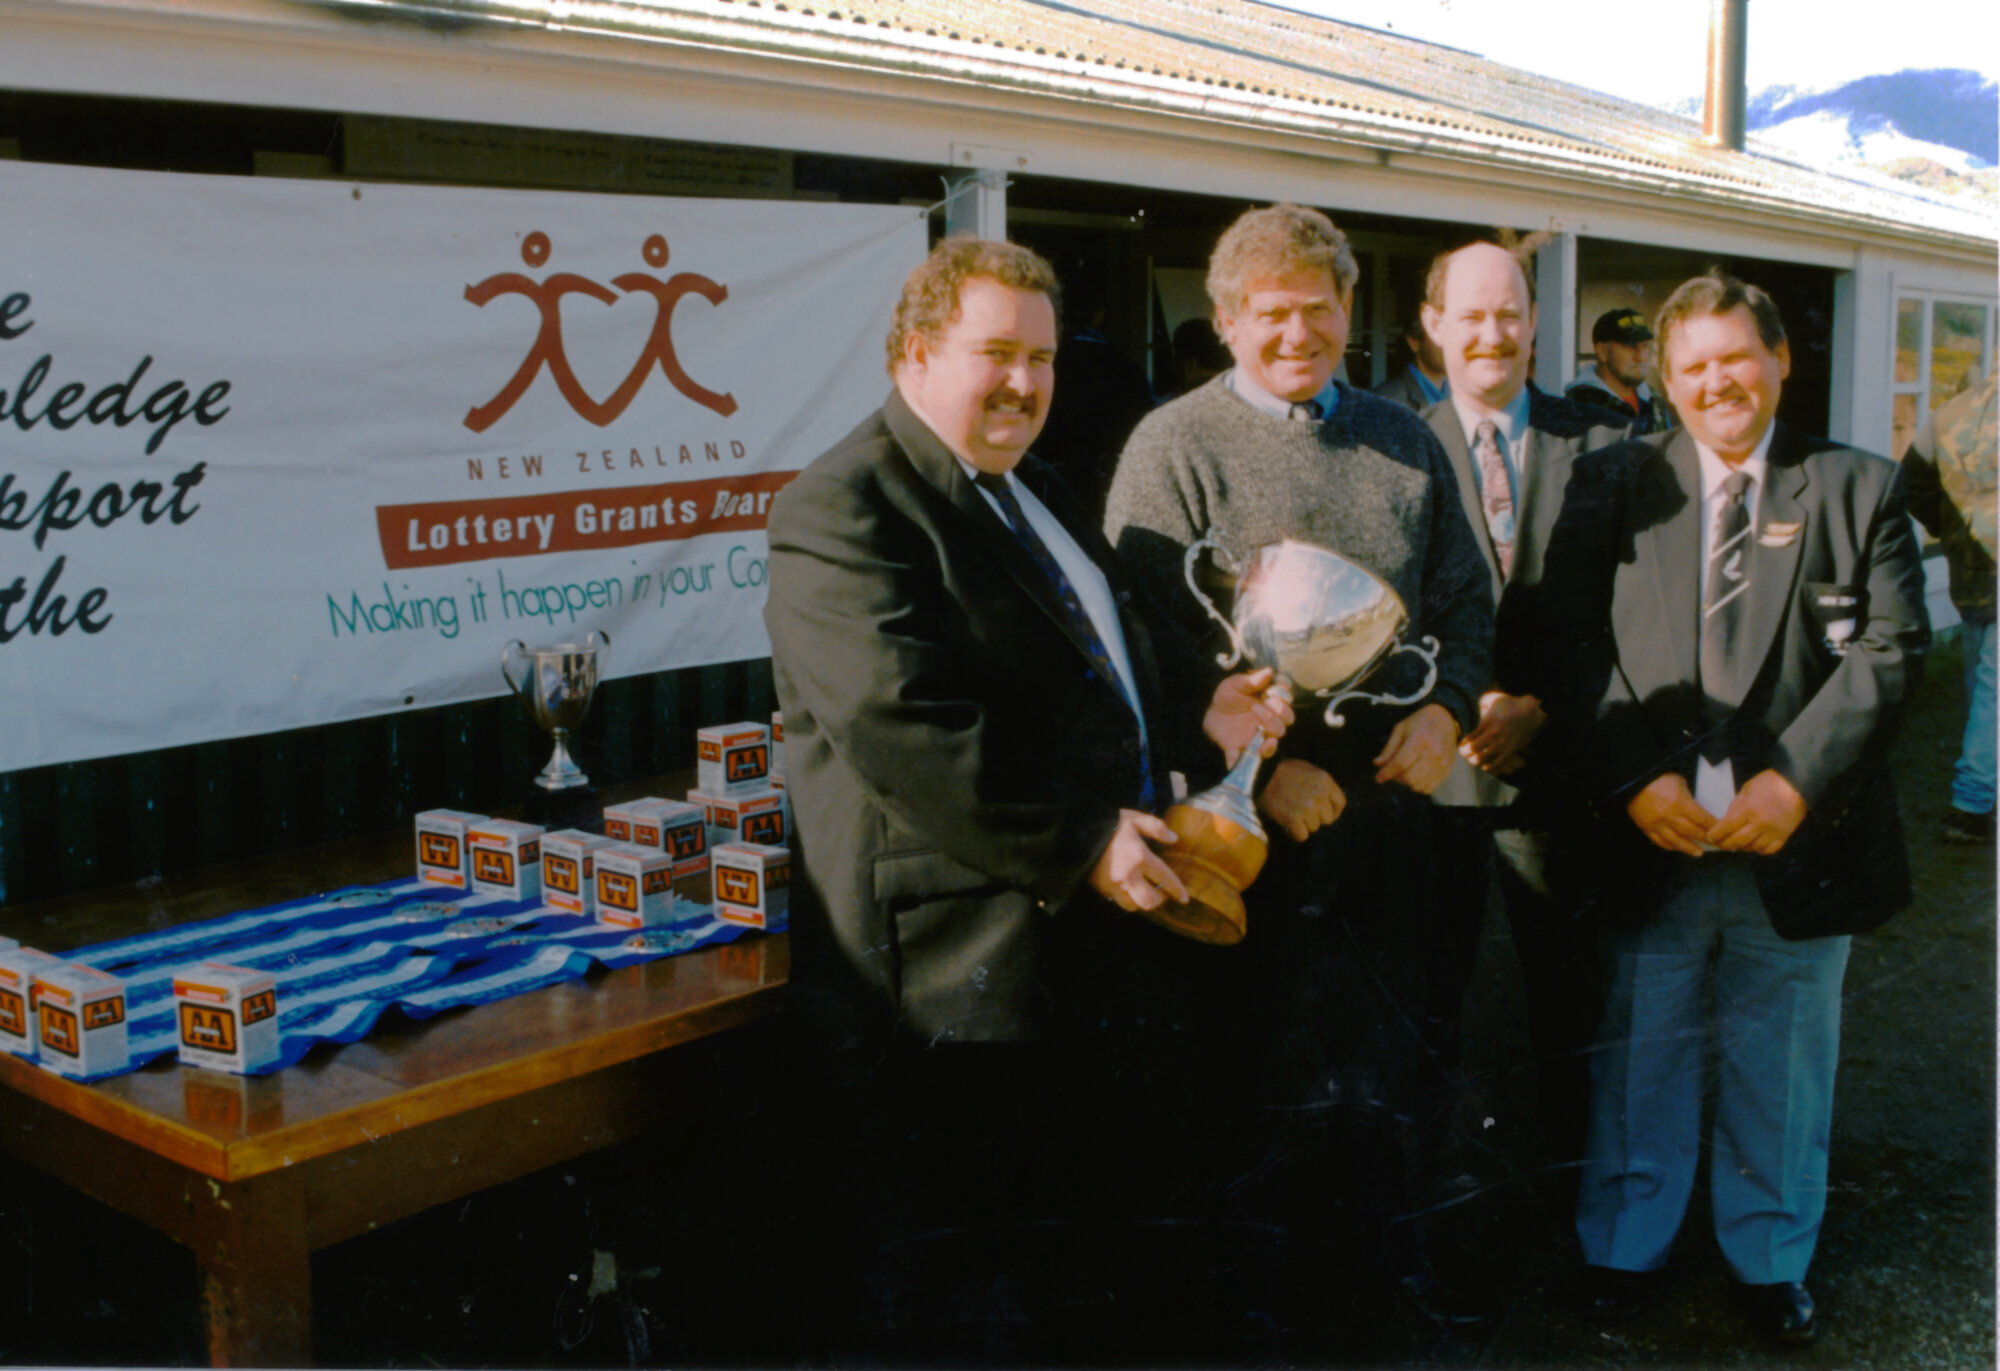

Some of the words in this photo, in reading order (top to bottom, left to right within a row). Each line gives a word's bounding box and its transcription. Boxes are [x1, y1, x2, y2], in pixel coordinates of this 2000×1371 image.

[0, 353, 232, 456] ledge
[467, 456, 544, 480] NEW
[577, 440, 747, 473] ZEALAND
[408, 514, 556, 551] Lottery
[575, 497, 698, 535] Grants
[0, 554, 114, 644] the
[326, 581, 461, 640] Making
[467, 577, 489, 622] it
[498, 569, 623, 626] happen
[632, 559, 653, 602] in
[659, 562, 715, 608] your
